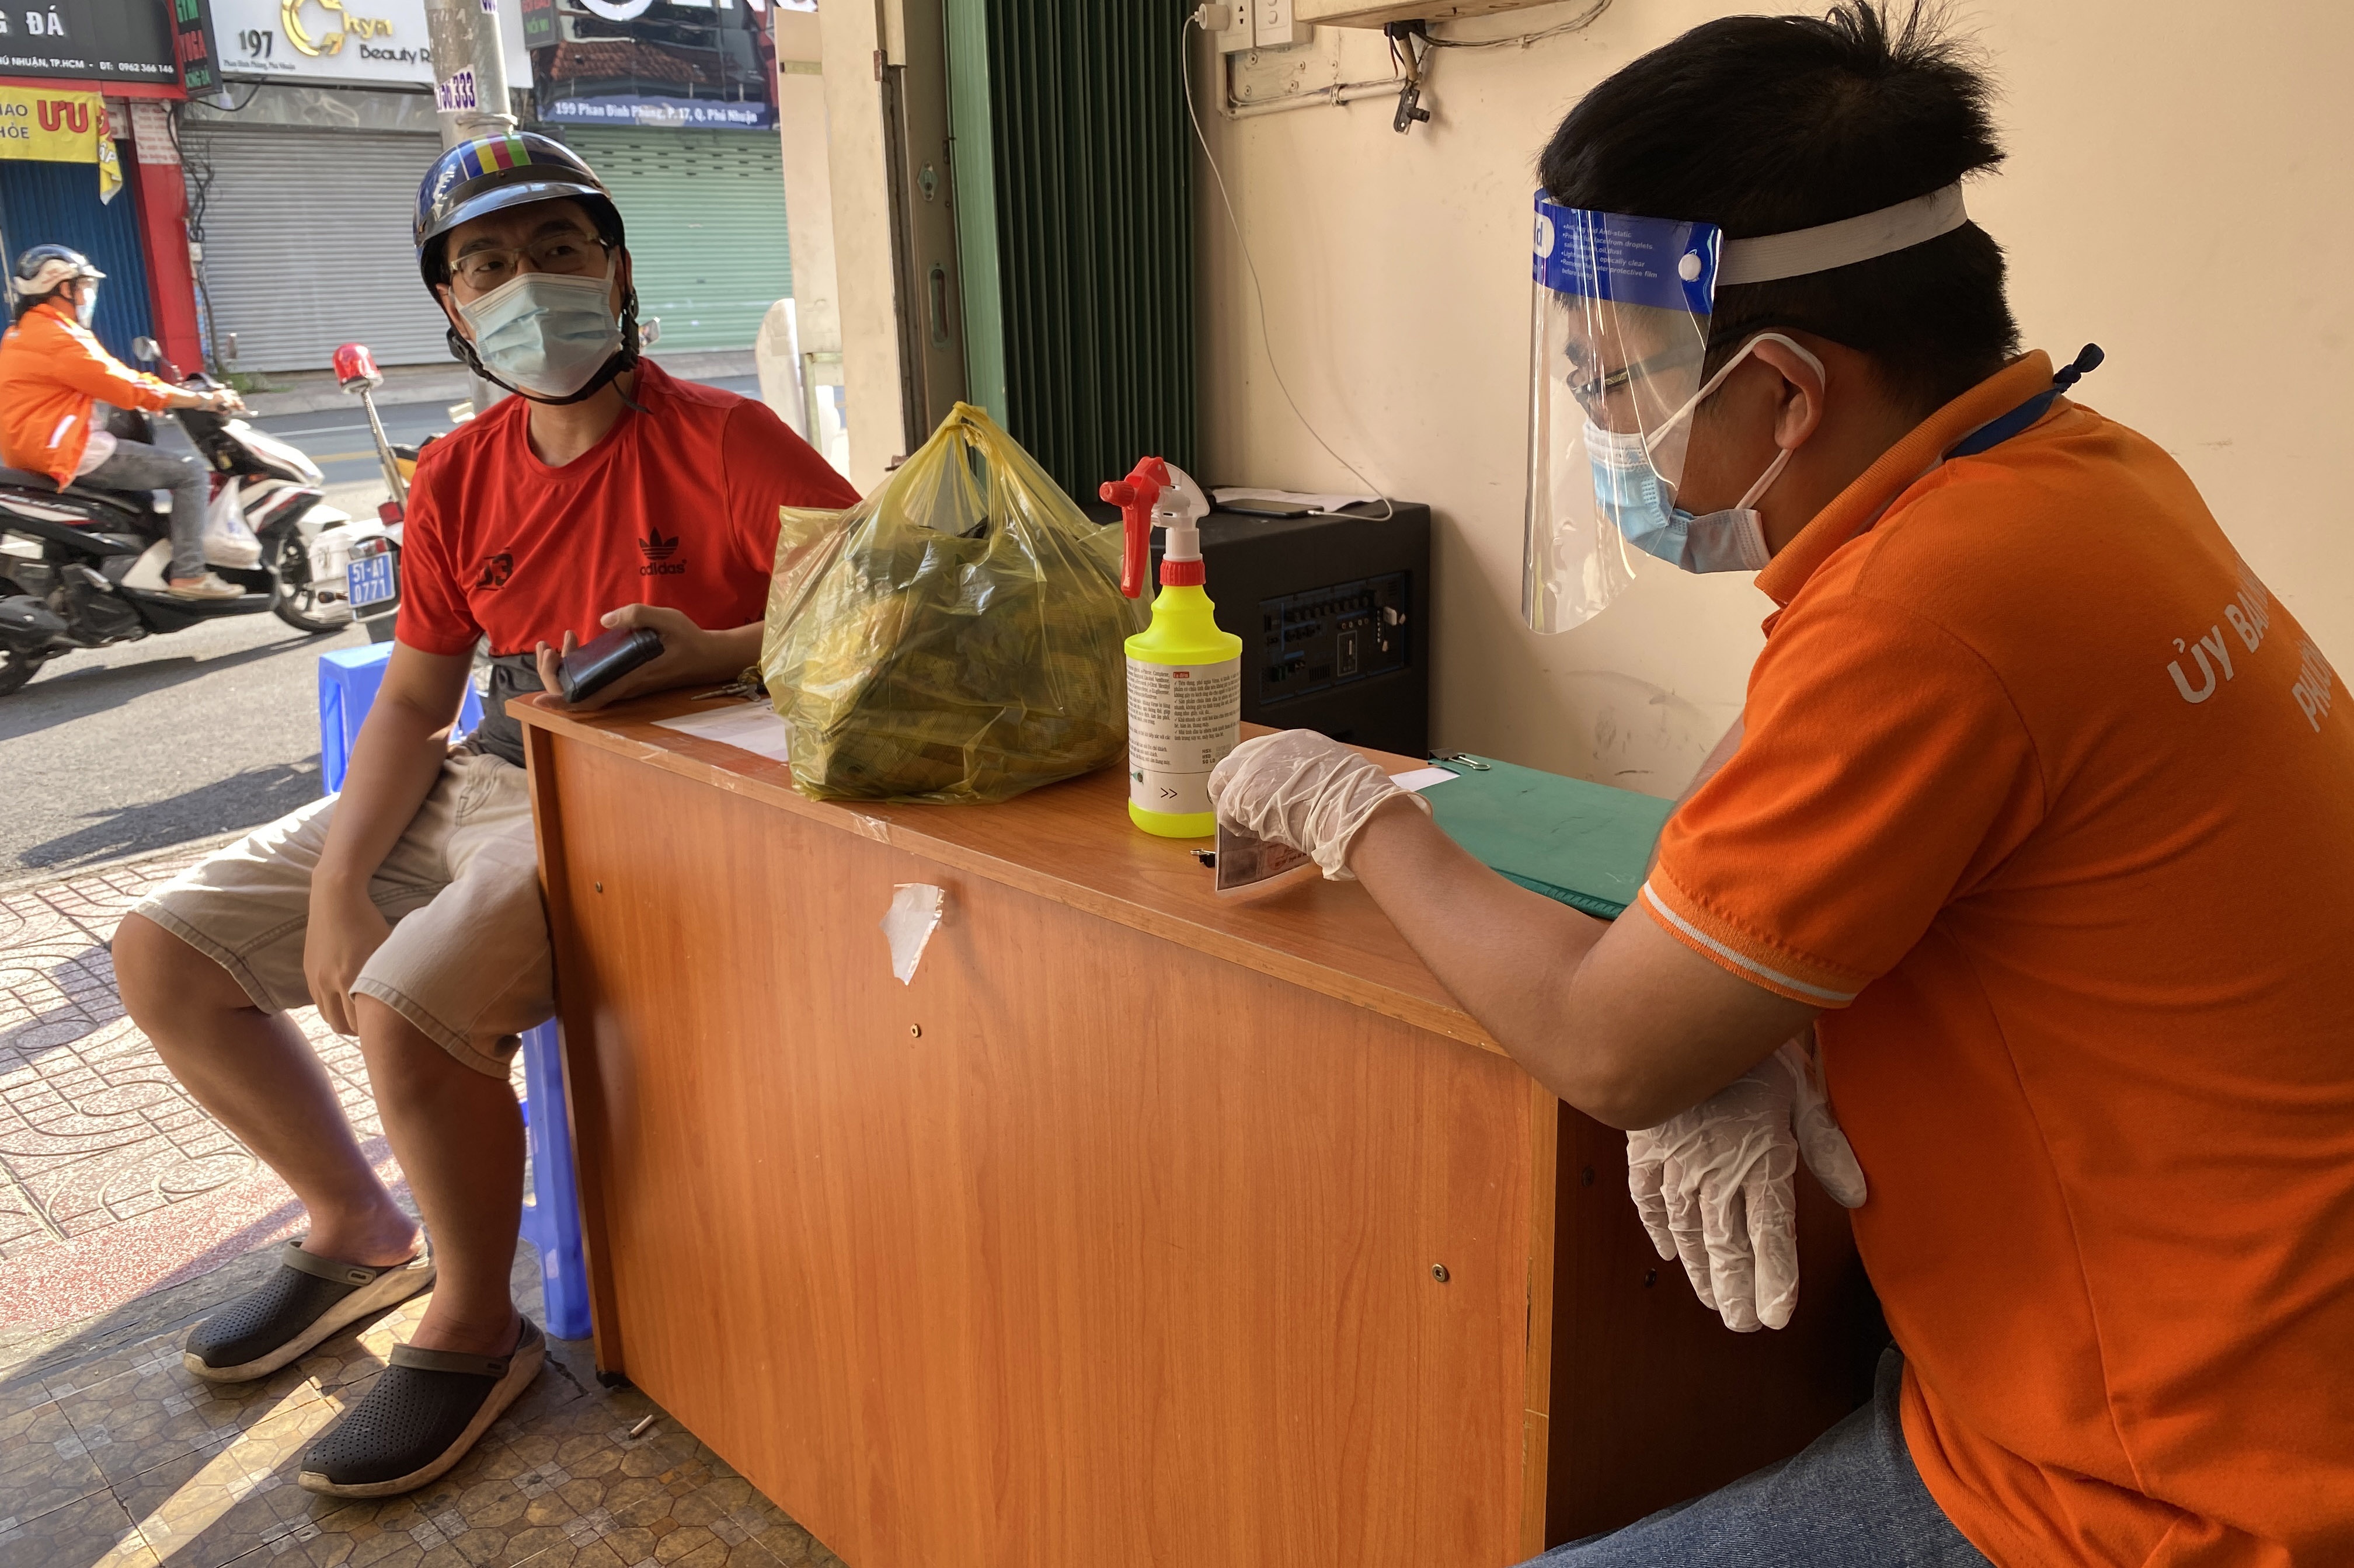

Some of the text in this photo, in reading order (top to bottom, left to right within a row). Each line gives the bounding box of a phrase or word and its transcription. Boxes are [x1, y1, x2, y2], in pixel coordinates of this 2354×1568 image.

[26, 5, 64, 36] ĐÁ
[239, 29, 273, 58] 197
[360, 44, 431, 64] Beauty R
[50, 59, 85, 68] TP.HCM
[119, 62, 140, 72] 0962
[141, 64, 157, 72] 366
[158, 64, 174, 74] 146
[37, 100, 89, 133] ƯU
[555, 102, 577, 116] 199
[577, 103, 605, 116] Phan
[1610, 267, 1643, 276] protective
[353, 557, 384, 583] 51-A1
[640, 562, 685, 576] adidas
[355, 579, 385, 603] 0771
[2167, 625, 2234, 703] ỦY
